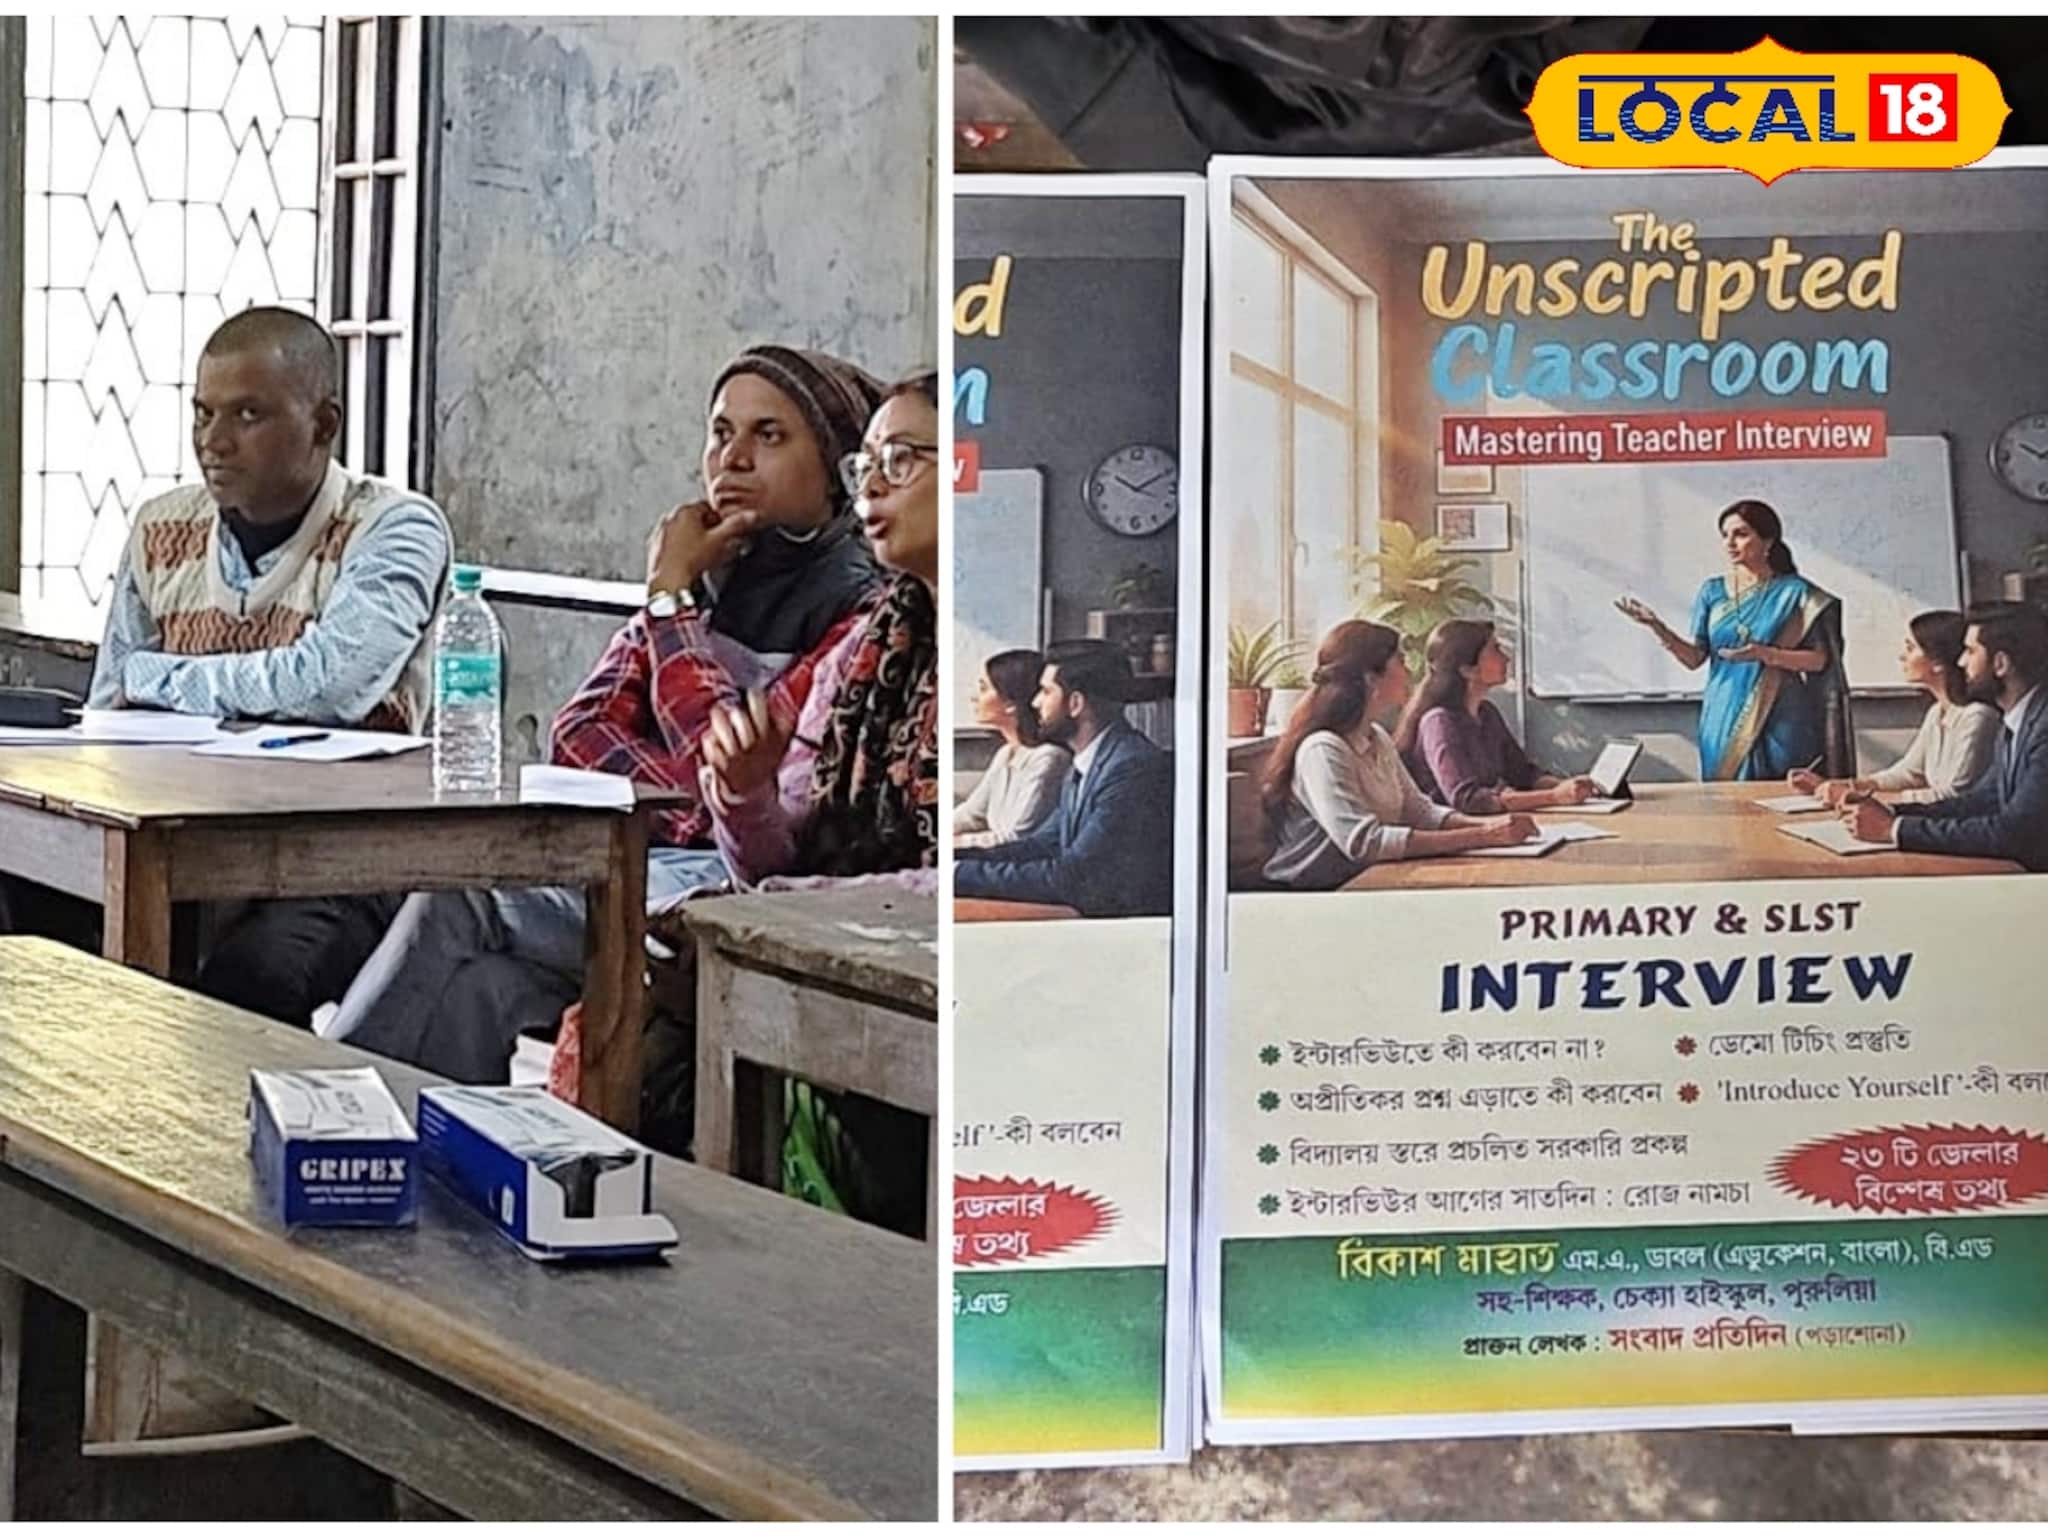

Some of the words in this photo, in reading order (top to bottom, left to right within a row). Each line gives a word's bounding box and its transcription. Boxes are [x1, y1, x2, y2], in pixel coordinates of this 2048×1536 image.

[1613, 211, 1693, 251] The
[1422, 229, 1901, 339] Unscripted
[1431, 323, 1888, 401] Classroom
[1455, 424, 1602, 462] Mastering
[1612, 422, 1724, 454] Teacher
[1737, 420, 1872, 451] Interview
[1501, 905, 1697, 940] PRIMARY
[1715, 903, 1747, 934] &
[1765, 901, 1861, 932] SLST
[1441, 953, 1913, 1012] INTERVIEW
[1288, 1037, 1434, 1068] ইন্টারভিউতে
[1441, 1034, 1468, 1062] কী
[1476, 1039, 1556, 1062] করবেন
[1710, 1033, 1774, 1056] ডেমো
[1783, 1026, 1836, 1054] টিচিং
[1846, 1024, 1911, 1053] প্রস্তুতি
[1290, 1083, 1405, 1113] অপ্রীতিকর
[1414, 1088, 1452, 1109] প্রশ্ন
[1460, 1086, 1538, 1112] এড়াতে
[1547, 1077, 1573, 1105] কী
[1581, 1082, 1662, 1105] করবেন
[1041, 1121, 1121, 1144] বলবেন
[1290, 1137, 1379, 1167] বিদ্যালয়
[1387, 1142, 1440, 1164] স্তরে
[1448, 1132, 1529, 1163] প্রচলিত
[1536, 1129, 1622, 1159] সরকারি
[1630, 1133, 1688, 1156] প্রকল্প
[1840, 1145, 1885, 1168] ২৩
[1892, 1137, 1918, 1167] টি
[1928, 1140, 2019, 1167] জেলার
[1286, 1186, 1418, 1218] ইন্টারভিউর
[1425, 1189, 1503, 1213] আগের
[1510, 1180, 1596, 1210] সাতদিন
[1623, 1183, 1680, 1207] রোজ
[1687, 1182, 1750, 1205] নামচা
[1855, 1174, 1943, 1205] বিশেষ
[1951, 1176, 2008, 1202] তথ্য
[972, 1230, 1031, 1258] তথ্য
[1337, 1236, 1446, 1280] বিকাশ
[1645, 1245, 1706, 1271] ডাবল
[1926, 1232, 1994, 1262] বি.এড
[1784, 1272, 1876, 1311] পুরুলিয়া
[1464, 1335, 1520, 1358] প্রাক্তন
[1528, 1332, 1586, 1355] লেখক
[1609, 1326, 1682, 1353] সংবাদ
[1692, 1316, 1786, 1350] প্রতিদিন
